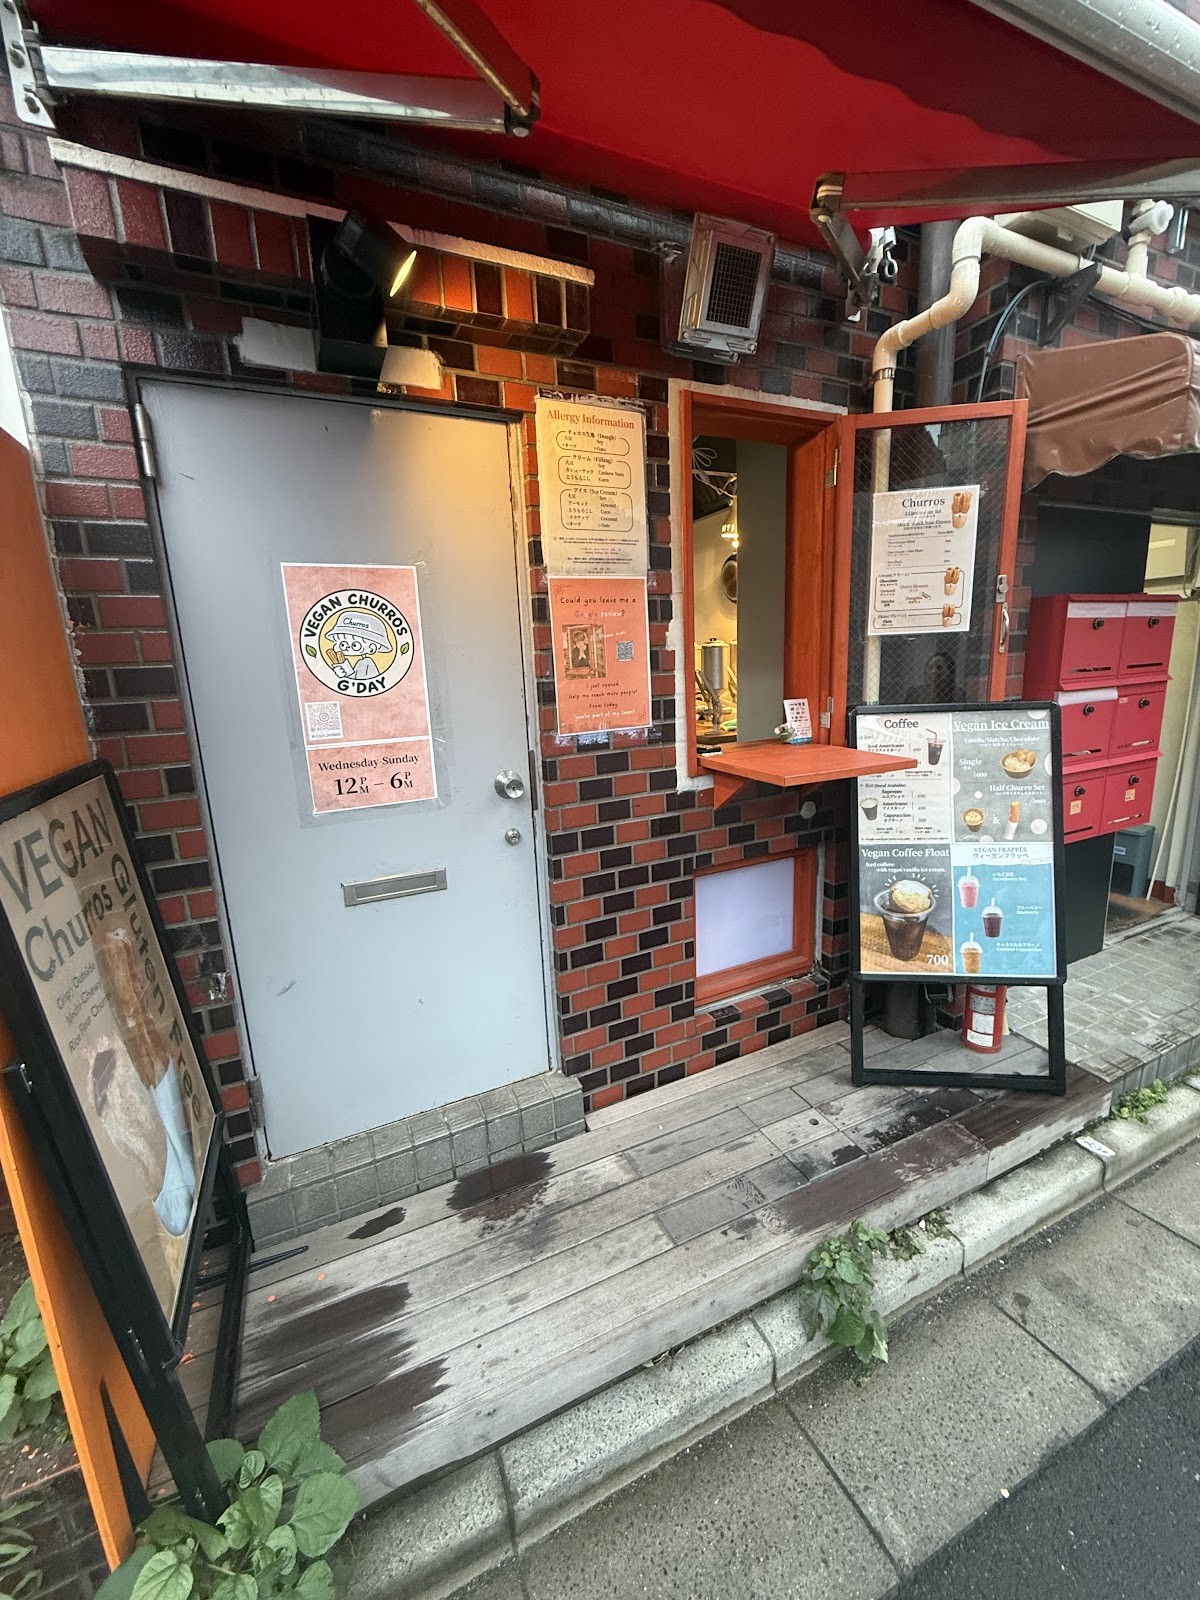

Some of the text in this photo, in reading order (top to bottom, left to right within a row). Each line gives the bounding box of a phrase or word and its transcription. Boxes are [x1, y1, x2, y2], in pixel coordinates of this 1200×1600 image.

[547, 410, 635, 429] Allergy Information
[902, 497, 945, 508] Churros
[585, 598, 596, 606] you
[304, 593, 407, 638] VEGAN CHURROS
[575, 611, 598, 620] Google
[342, 617, 369, 628] Churros
[337, 676, 385, 694] G'DAY
[884, 719, 919, 728] Coffee
[953, 719, 1049, 732] Vegan Ice Cream
[959, 758, 982, 766] Single
[0, 798, 113, 914] VEGAN
[862, 848, 949, 859] Vegan Coffee Float
[24, 884, 113, 982] Churros
[927, 954, 948, 966] 700
[73, 962, 95, 988] Outside
[111, 853, 201, 1122] Gluten Free
[68, 1034, 81, 1053] Rice
